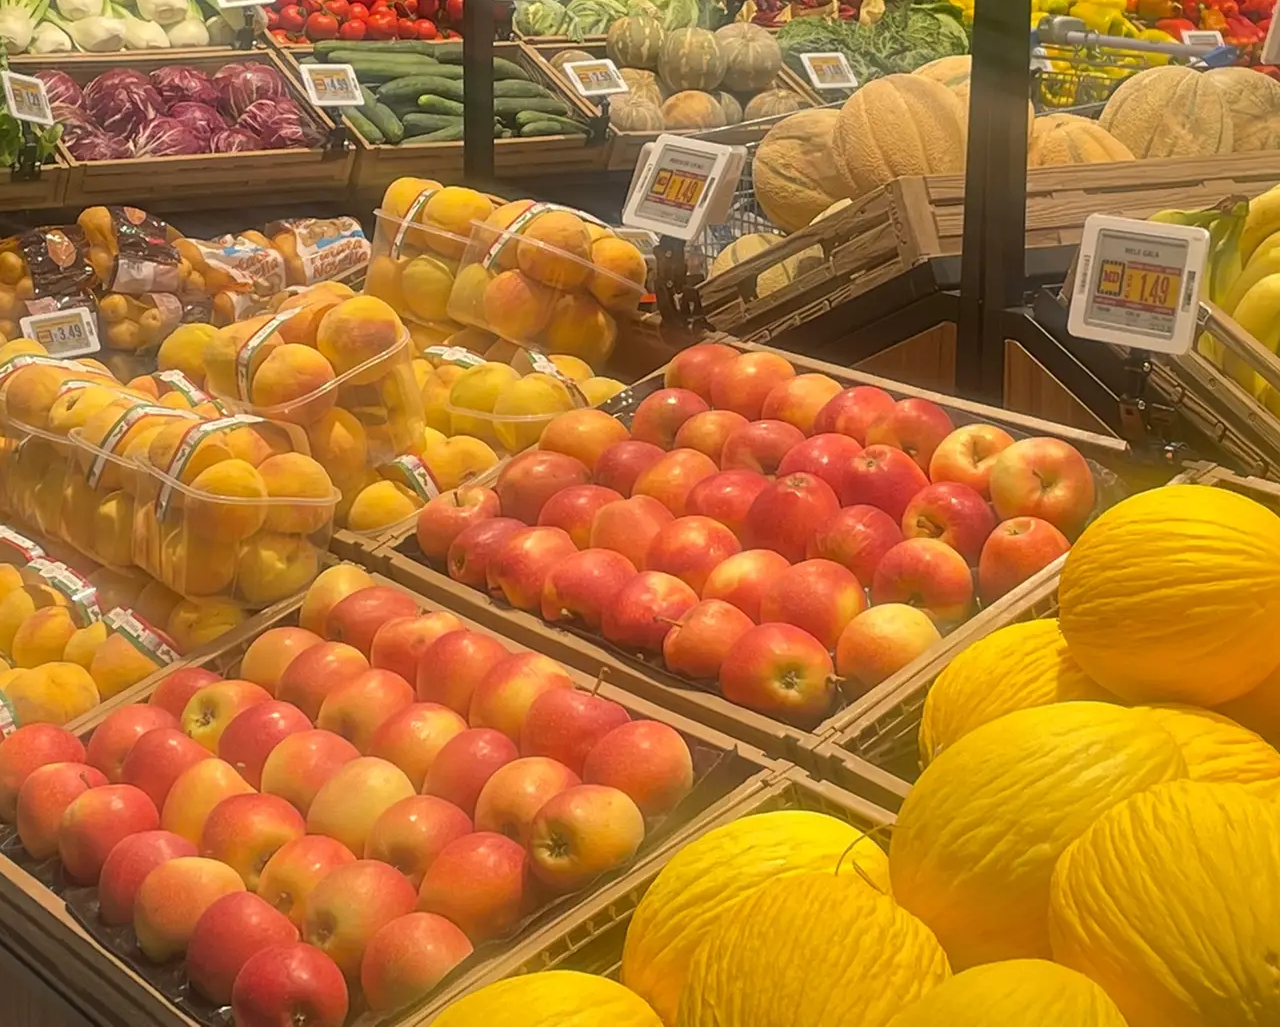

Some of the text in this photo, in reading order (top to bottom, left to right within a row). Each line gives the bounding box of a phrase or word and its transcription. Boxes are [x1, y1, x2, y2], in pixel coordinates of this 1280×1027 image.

[675, 178, 699, 203] 1.49
[1138, 273, 1170, 306] 1.49
[60, 324, 82, 339] 3.49
